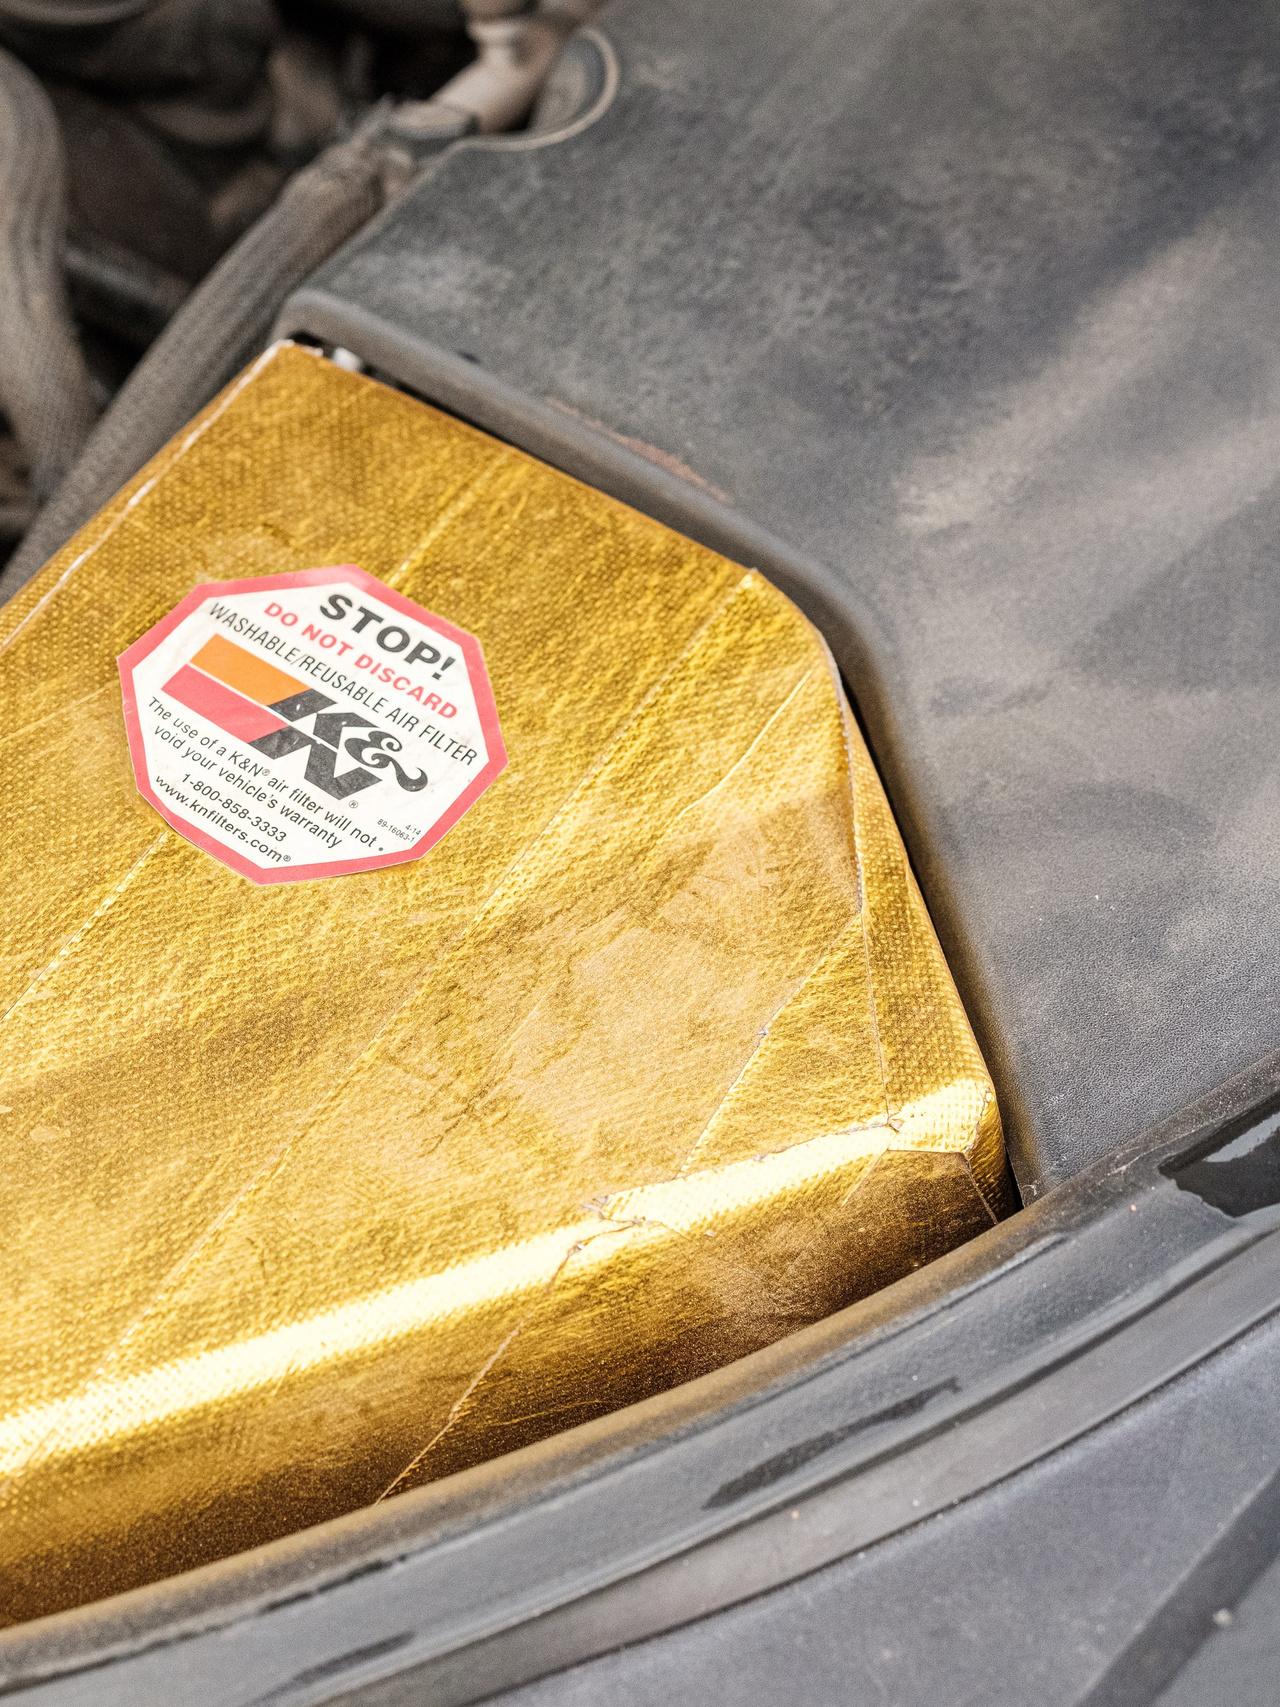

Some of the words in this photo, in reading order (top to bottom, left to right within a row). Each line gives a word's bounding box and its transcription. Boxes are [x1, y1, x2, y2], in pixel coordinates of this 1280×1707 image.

[209, 602, 389, 714] WASHABLE/REUSABLE
[385, 707, 420, 732] AIR
[418, 724, 478, 766] FILTER
[264, 602, 299, 627] DO
[301, 623, 354, 656] NOT
[354, 653, 458, 719] DISCARD
[320, 594, 456, 680] STOP!
[148, 696, 172, 720] The
[173, 717, 198, 739] use
[200, 736, 219, 750] of
[216, 746, 227, 757] a
[267, 777, 289, 793] air
[288, 788, 324, 814] filter
[324, 810, 352, 831] will
[349, 827, 378, 847] not
[154, 725, 186, 749] void
[181, 747, 218, 771] your
[219, 767, 278, 809] vehicle's
[279, 805, 343, 849] warranty
[182, 773, 287, 842] 1-800-858-3333
